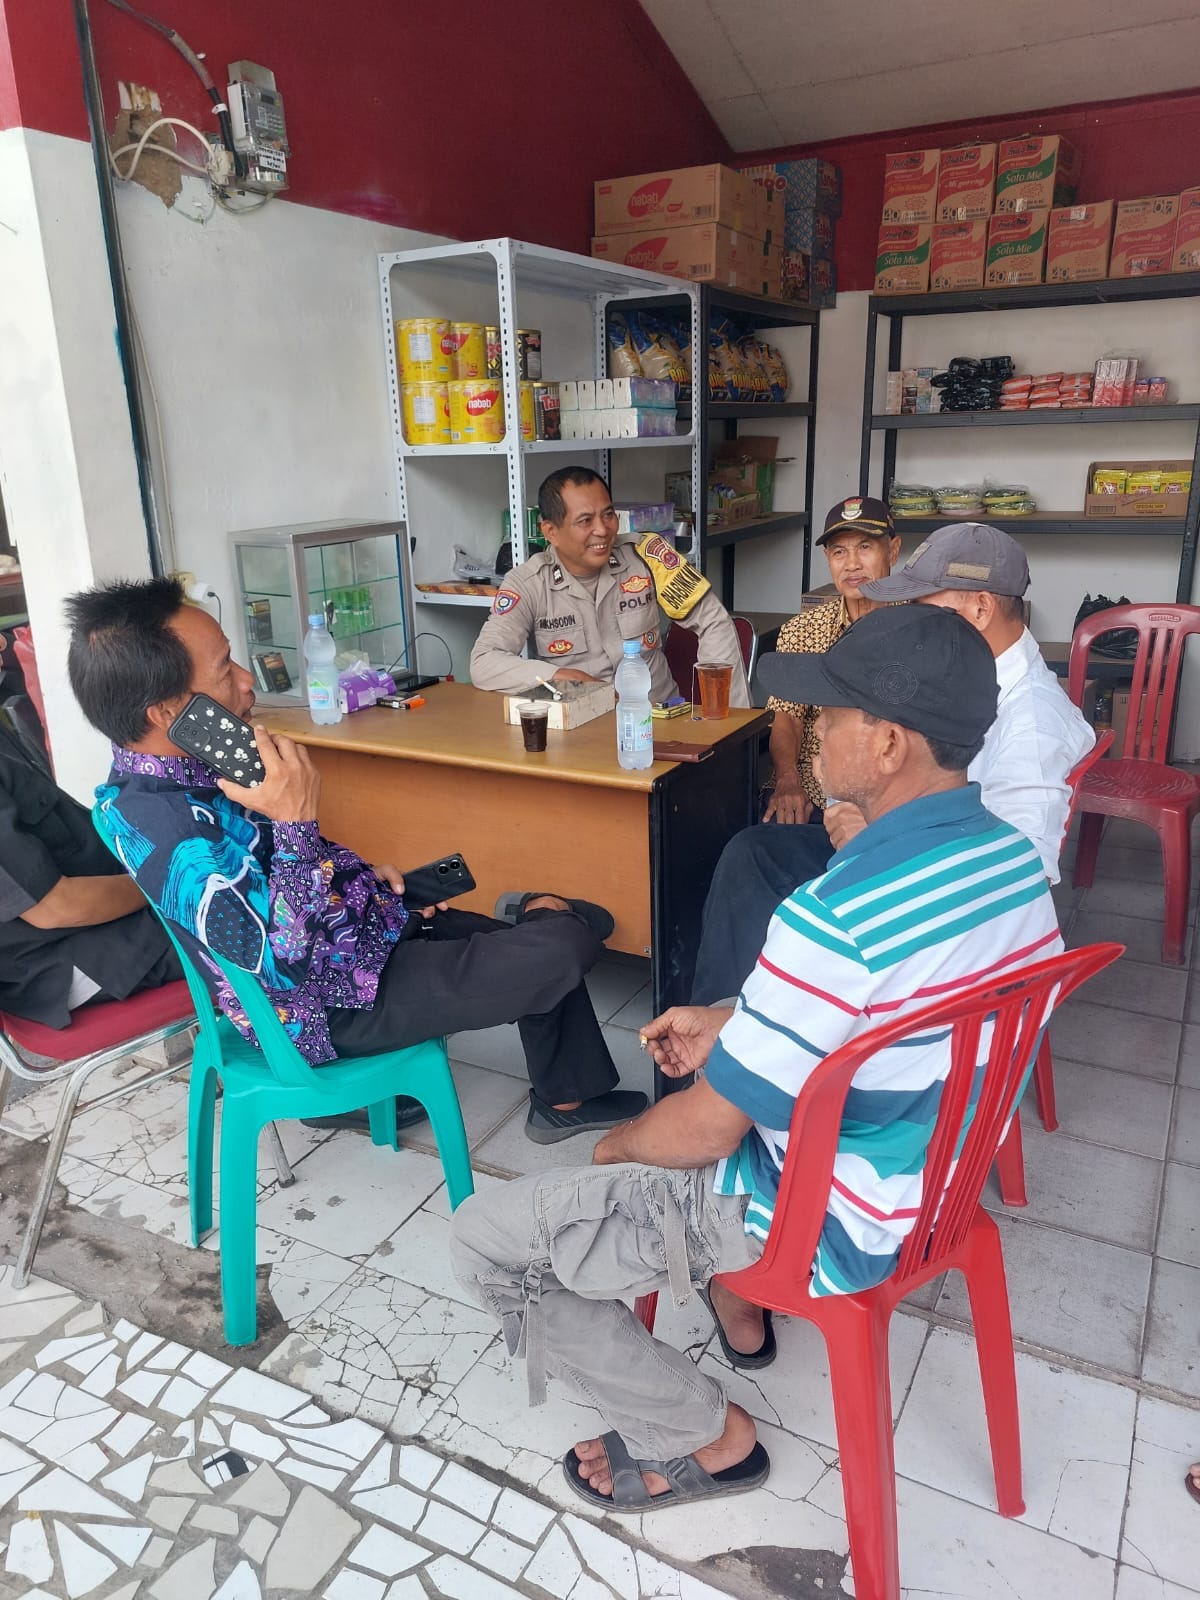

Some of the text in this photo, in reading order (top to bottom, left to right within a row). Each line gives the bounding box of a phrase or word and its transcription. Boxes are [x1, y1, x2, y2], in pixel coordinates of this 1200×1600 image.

[1005, 173, 1025, 184] Soto
[631, 191, 658, 207] nabati
[996, 243, 1032, 256] Soto Mie
[884, 256, 902, 265] Soto
